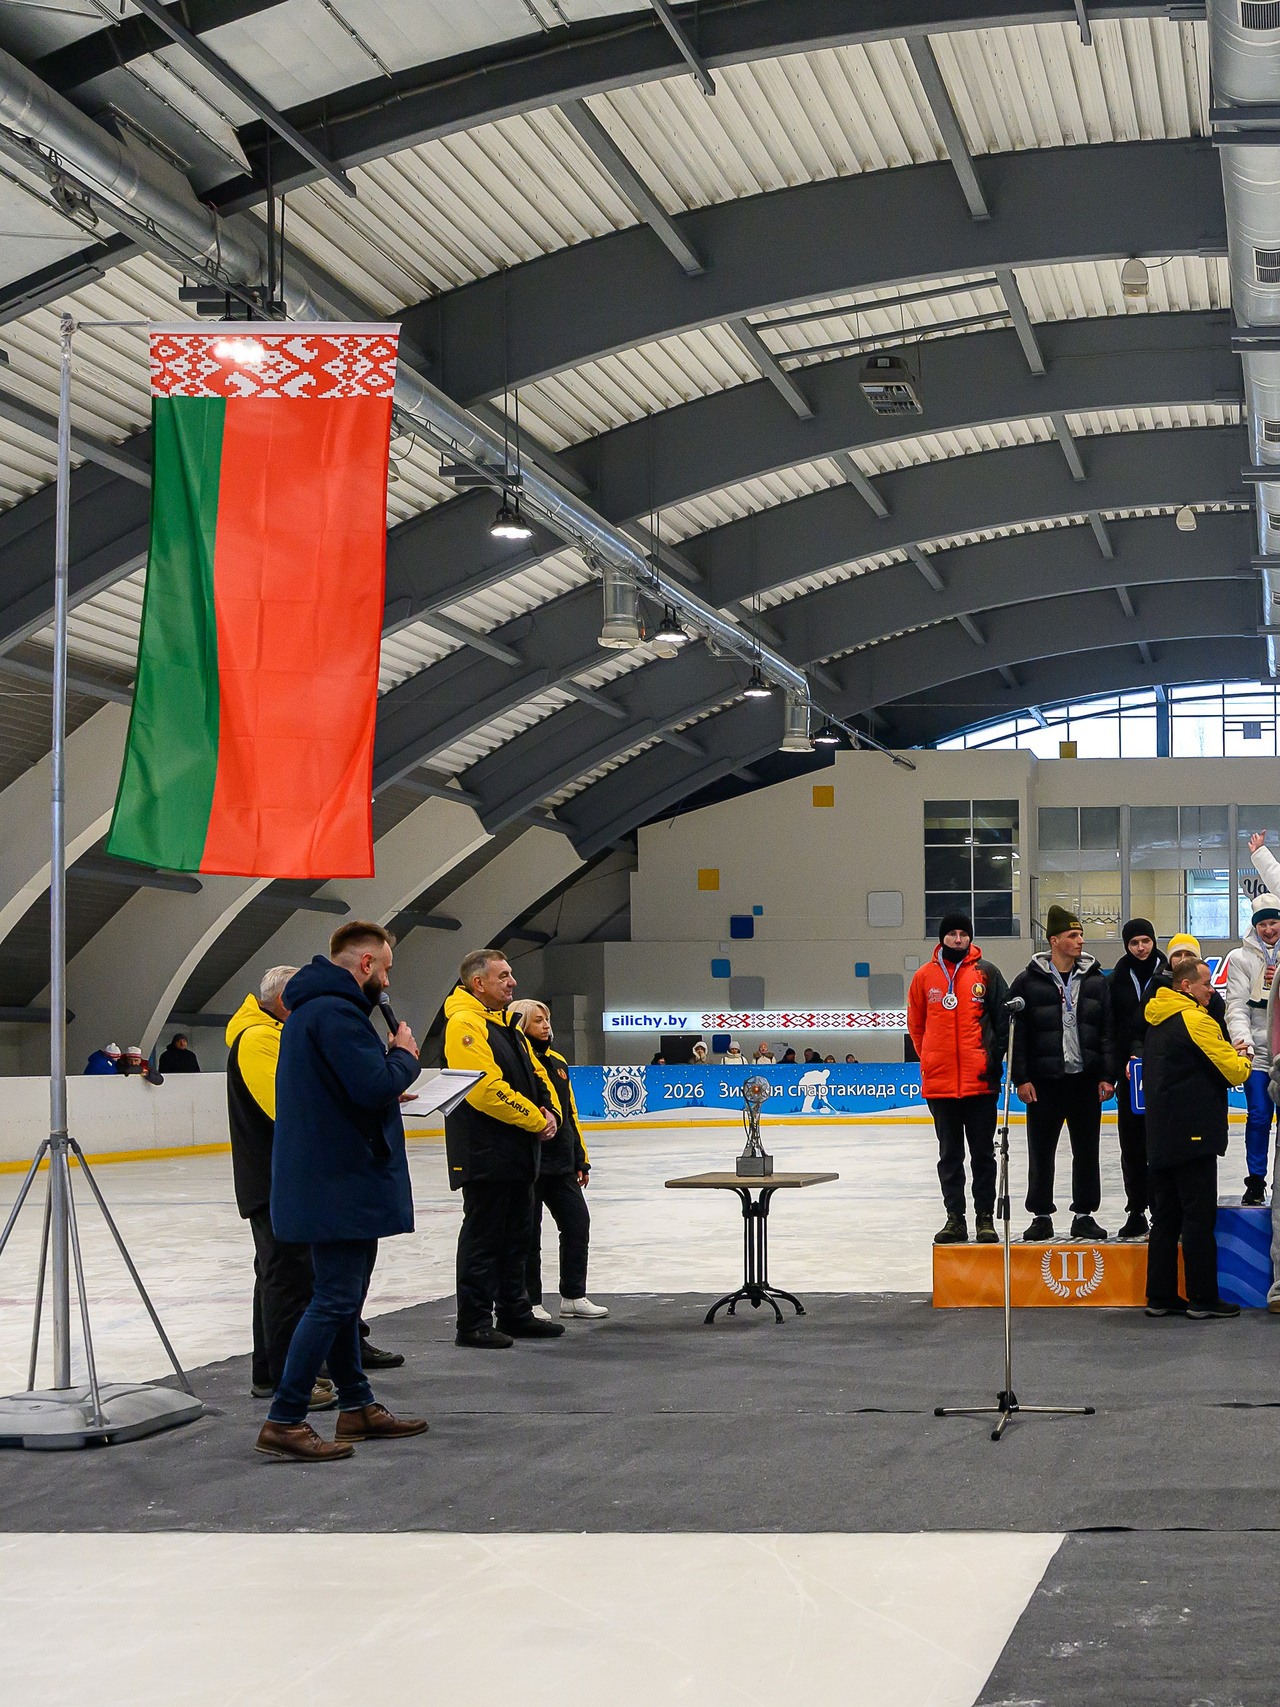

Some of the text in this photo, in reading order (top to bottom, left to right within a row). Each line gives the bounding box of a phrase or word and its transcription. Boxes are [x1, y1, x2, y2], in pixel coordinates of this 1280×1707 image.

[612, 1014, 687, 1028] silichy.by
[663, 1083, 705, 1099] 2026
[788, 1084, 896, 1100] спартакиада
[900, 1084, 923, 1099] ср
[496, 1090, 530, 1117] BELARUS
[1057, 1251, 1088, 1282] II
